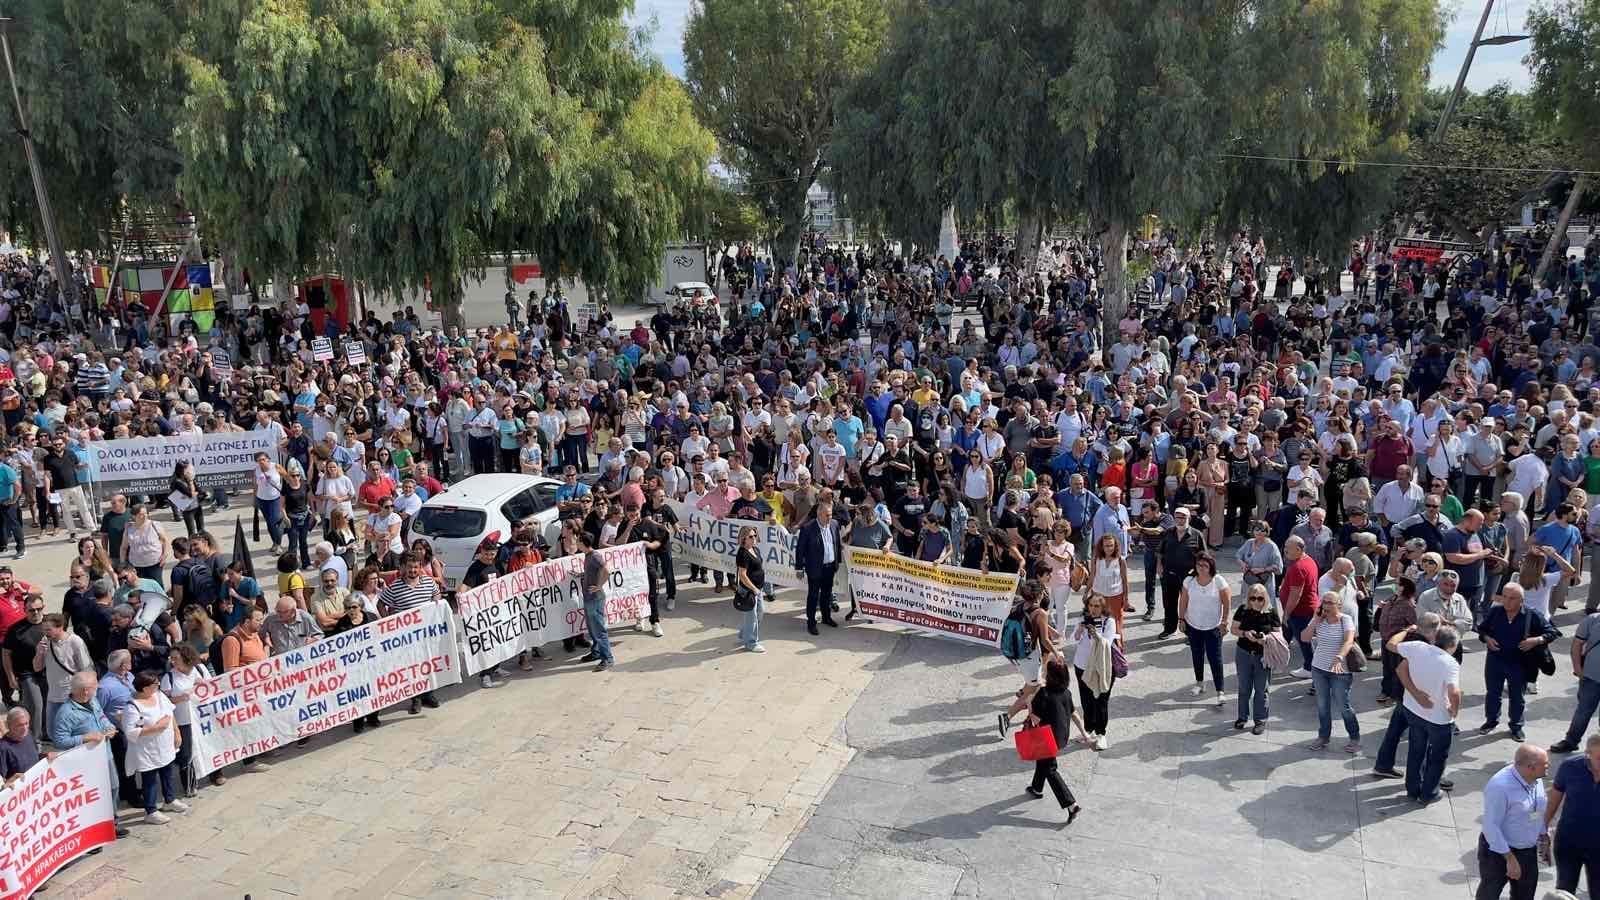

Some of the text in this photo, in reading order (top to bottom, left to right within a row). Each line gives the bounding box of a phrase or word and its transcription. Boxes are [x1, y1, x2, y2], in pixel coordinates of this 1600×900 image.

[97, 438, 270, 460] ΟΛΟΙ ΜΑΖΙ ΣΤΟΥΣ ΑΓΩΝΕΣ ΓΙΑ
[200, 452, 257, 466] ΑΞΙΟΠΡΕΠ
[673, 532, 796, 567] ΔΗΜΟΣ ΑΓΑ
[690, 513, 702, 530] Η
[707, 520, 739, 540] ΥΓΕ
[471, 579, 507, 609] ΥΓΕΙΑ
[512, 571, 534, 593] ΔΕΝ
[537, 562, 566, 585] ΕΙΝΑΙ
[504, 598, 521, 616] ΤΑ
[526, 585, 563, 609] ΧΕΡΙΑ
[856, 590, 879, 600] αζικές
[926, 603, 964, 618] ΜΟΝΙΜΟΥ
[882, 582, 914, 594] ΚΑΜΙΑ
[286, 652, 305, 669] ΝΑ
[310, 626, 371, 659] ΔΩΣΟΥΜΕ
[377, 609, 422, 634] ΤΕΛΟΣ
[469, 608, 547, 656] ΒΕΝΙΖΕΛΕΙΟ
[197, 621, 449, 719] ΣΤΗΝ ΕΓΚΛΗΜΑΤΙΚΗ ΤΟΥΣ ΠΟΛΙΤΙΚΗ
[298, 654, 452, 723] ΔΕΝ ΕΙΝΑΙ ΚΟΣΤΟΣ!
[200, 672, 347, 736] Η ΥΓΕΙΑ ΤΟΥ ΛΑΟΥ
[213, 679, 430, 768] ΕΡΓΑΤΙΚΑ ΣΩΜΑΤΕΙΑ ΗΡΑΚΛΕΙΟΥ
[10, 788, 100, 853] ΡΕΥΟΥΜΕ
[16, 809, 26, 826] Ο
[32, 774, 85, 815] ΛΑΟΣ
[35, 837, 81, 878] ΗΡΑΚΛΕΙΟΥ
